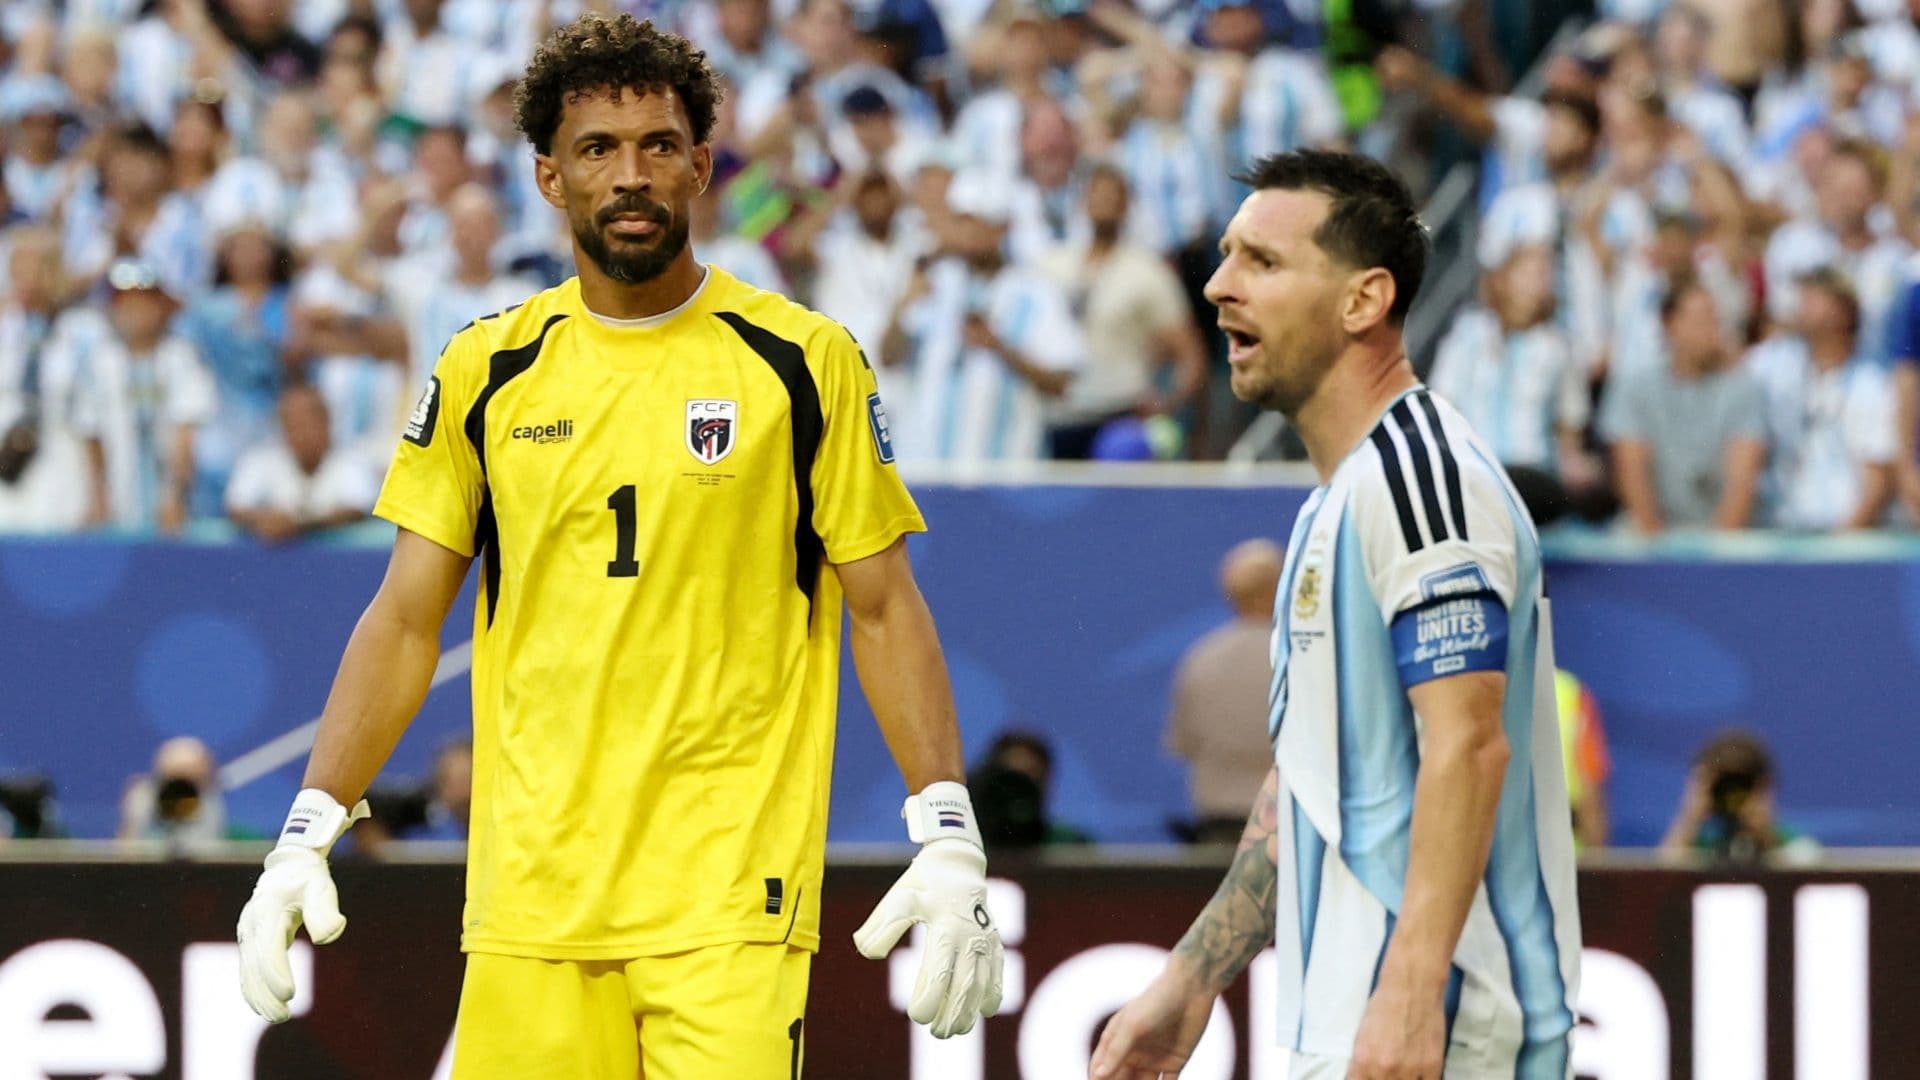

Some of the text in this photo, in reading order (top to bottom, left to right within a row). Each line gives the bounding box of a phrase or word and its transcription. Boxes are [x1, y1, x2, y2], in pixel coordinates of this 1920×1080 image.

[690, 402, 732, 412] FCF
[512, 419, 573, 443] capelli
[607, 485, 639, 577] 1
[1416, 612, 1486, 645] UNITES
